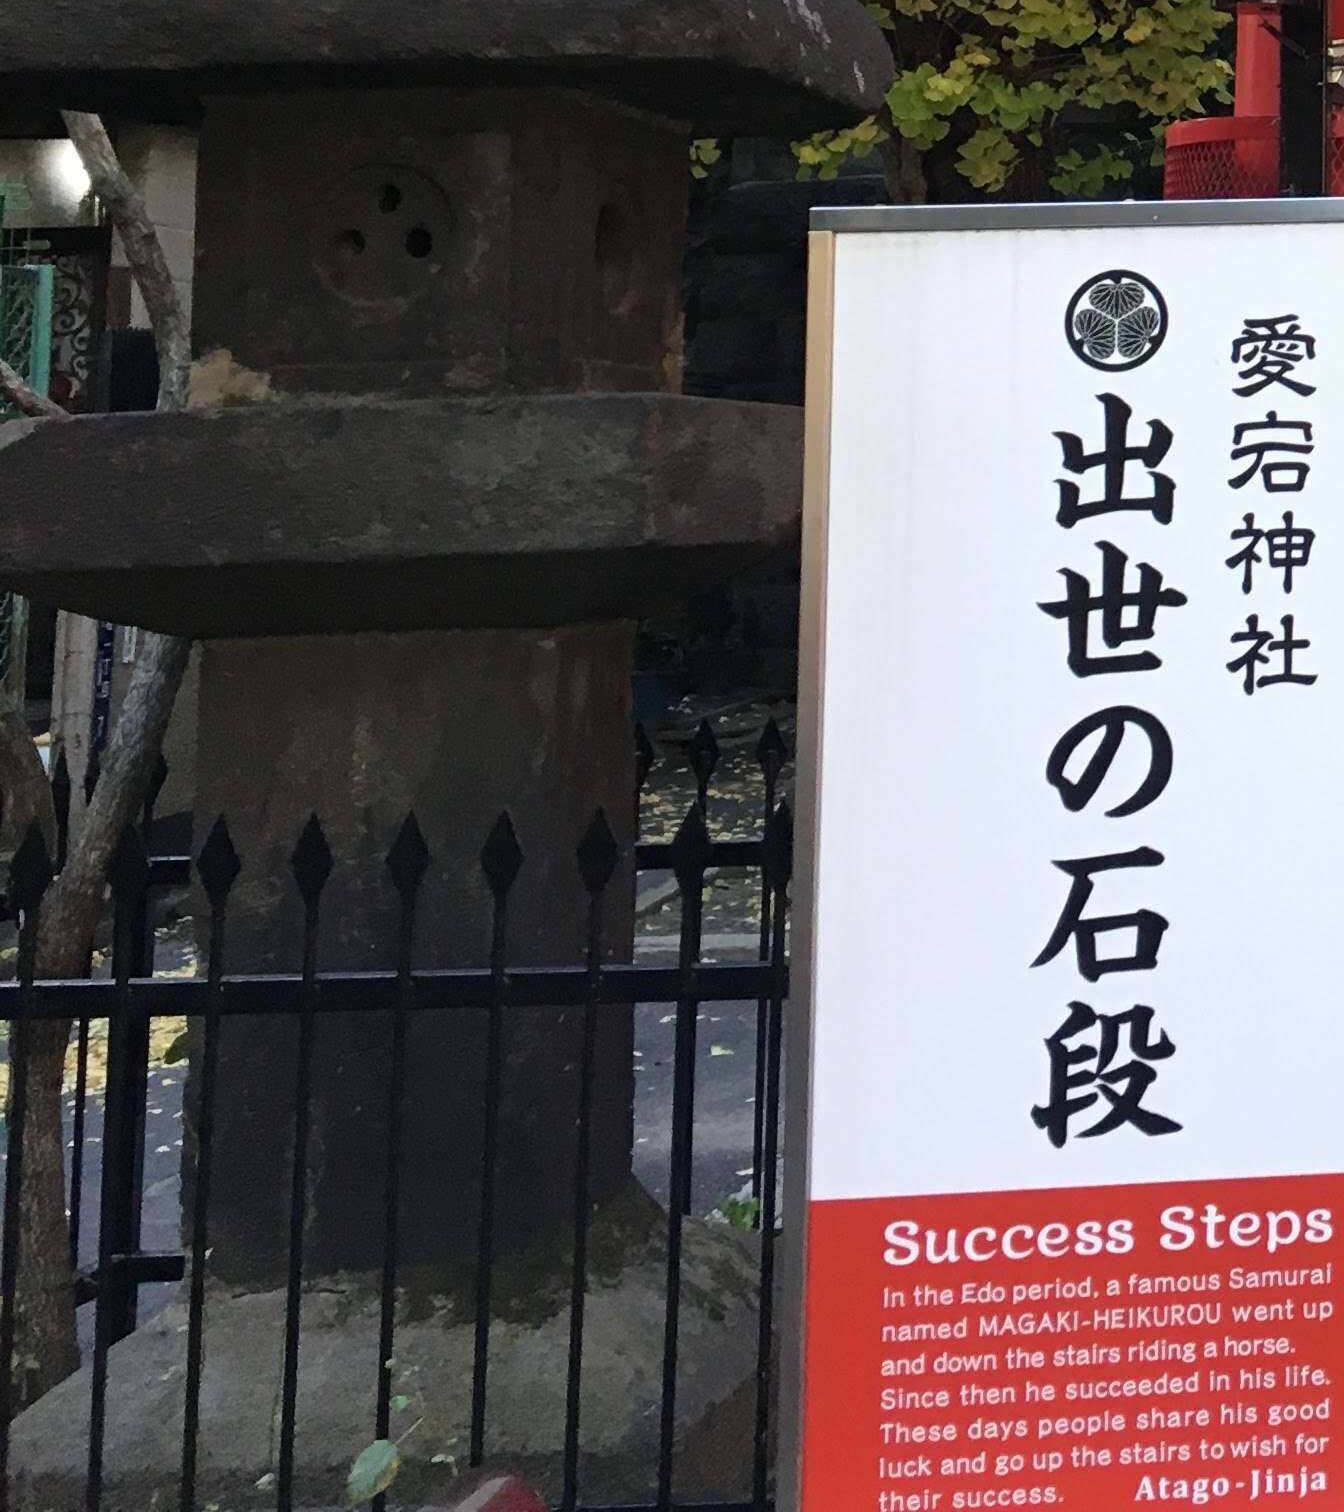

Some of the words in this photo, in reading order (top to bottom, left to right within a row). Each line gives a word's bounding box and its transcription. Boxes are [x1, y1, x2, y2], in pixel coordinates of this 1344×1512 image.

[1226, 315, 1317, 695] 愛宕神社
[1030, 393, 1187, 1148] 出世の石段
[883, 1219, 1135, 1266] Success
[1159, 1203, 1333, 1254] Steps
[883, 1287, 906, 1309] In
[912, 1284, 954, 1307] the
[960, 1281, 1006, 1304] Edo
[1012, 1276, 1099, 1305] period,
[1106, 1279, 1121, 1297] a
[1127, 1273, 1221, 1295] famous
[1228, 1262, 1332, 1290] Samurai
[882, 1316, 968, 1343] named
[978, 1302, 1221, 1337] MAGAKI-HEIKUROU
[1231, 1298, 1295, 1323] went
[1302, 1300, 1334, 1322] up
[880, 1352, 926, 1377] and
[933, 1351, 998, 1374] down
[1005, 1347, 1045, 1370] the
[1052, 1342, 1121, 1367] stairs
[1127, 1339, 1197, 1363] riding
[1203, 1341, 1218, 1359] a
[1224, 1335, 1296, 1357] horse.
[880, 1387, 950, 1411] Since
[959, 1383, 1016, 1407] then
[1025, 1381, 1056, 1402] he
[1064, 1371, 1199, 1400] succeeded
[1209, 1370, 1231, 1392] in
[1239, 1367, 1276, 1390] his
[1285, 1364, 1331, 1388] life.
[879, 1421, 958, 1444] These
[967, 1417, 1028, 1442] days
[1037, 1410, 1126, 1440] people
[1136, 1407, 1210, 1430] share
[1220, 1402, 1258, 1425] his
[1267, 1397, 1330, 1426] good
[879, 1455, 932, 1479] luck
[940, 1451, 986, 1476] and
[994, 1454, 1025, 1476] go
[1032, 1451, 1064, 1473] up
[1070, 1445, 1112, 1468] the
[1118, 1440, 1191, 1465] stairs
[1198, 1438, 1225, 1461] to
[1229, 1434, 1287, 1459] wish
[1294, 1432, 1330, 1455] for
[878, 1489, 943, 1512] their
[952, 1486, 1064, 1509] success.
[1133, 1465, 1327, 1505] Atago-Jinja
